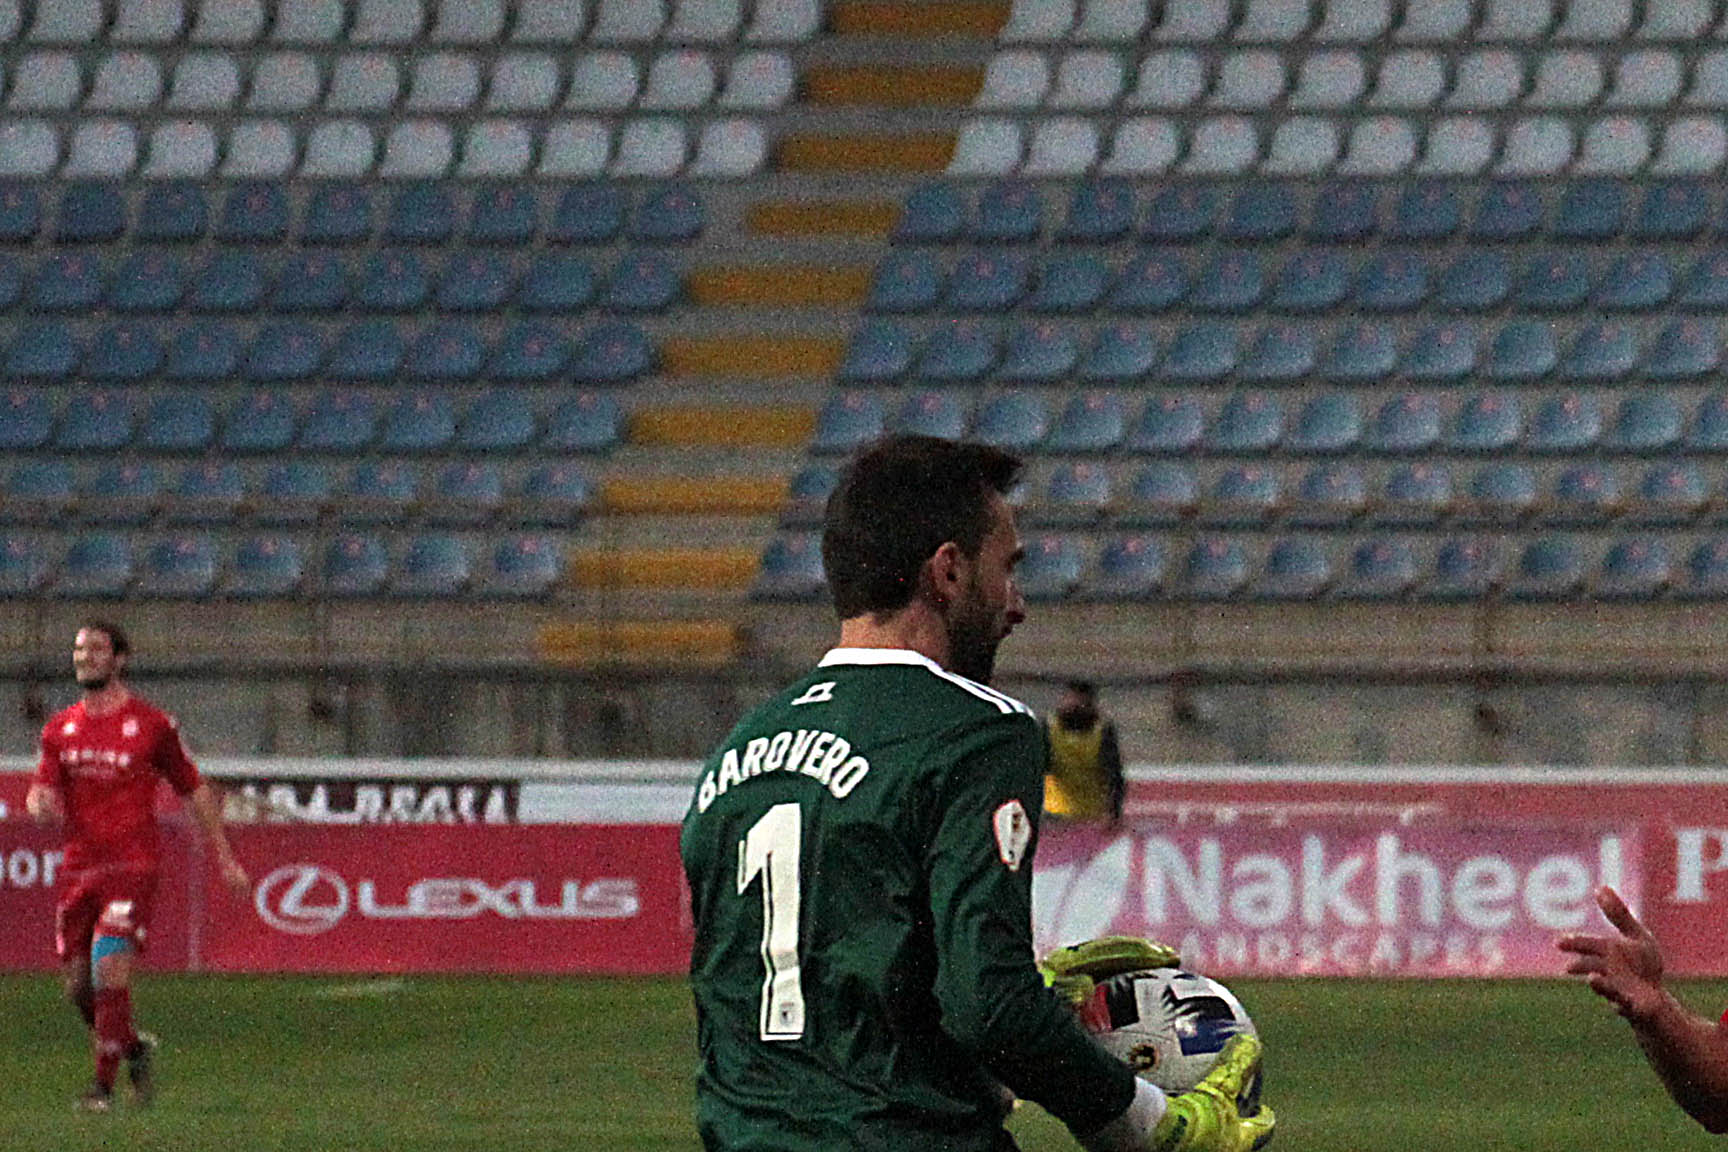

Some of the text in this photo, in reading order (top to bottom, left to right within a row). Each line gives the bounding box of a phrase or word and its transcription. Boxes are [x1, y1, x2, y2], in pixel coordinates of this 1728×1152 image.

[0, 850, 64, 888] or
[1142, 833, 1622, 930] Nakheel
[359, 877, 640, 919] LEXUS
[737, 802, 805, 1041] 1
[1181, 931, 1506, 969] ANDSCAPES
